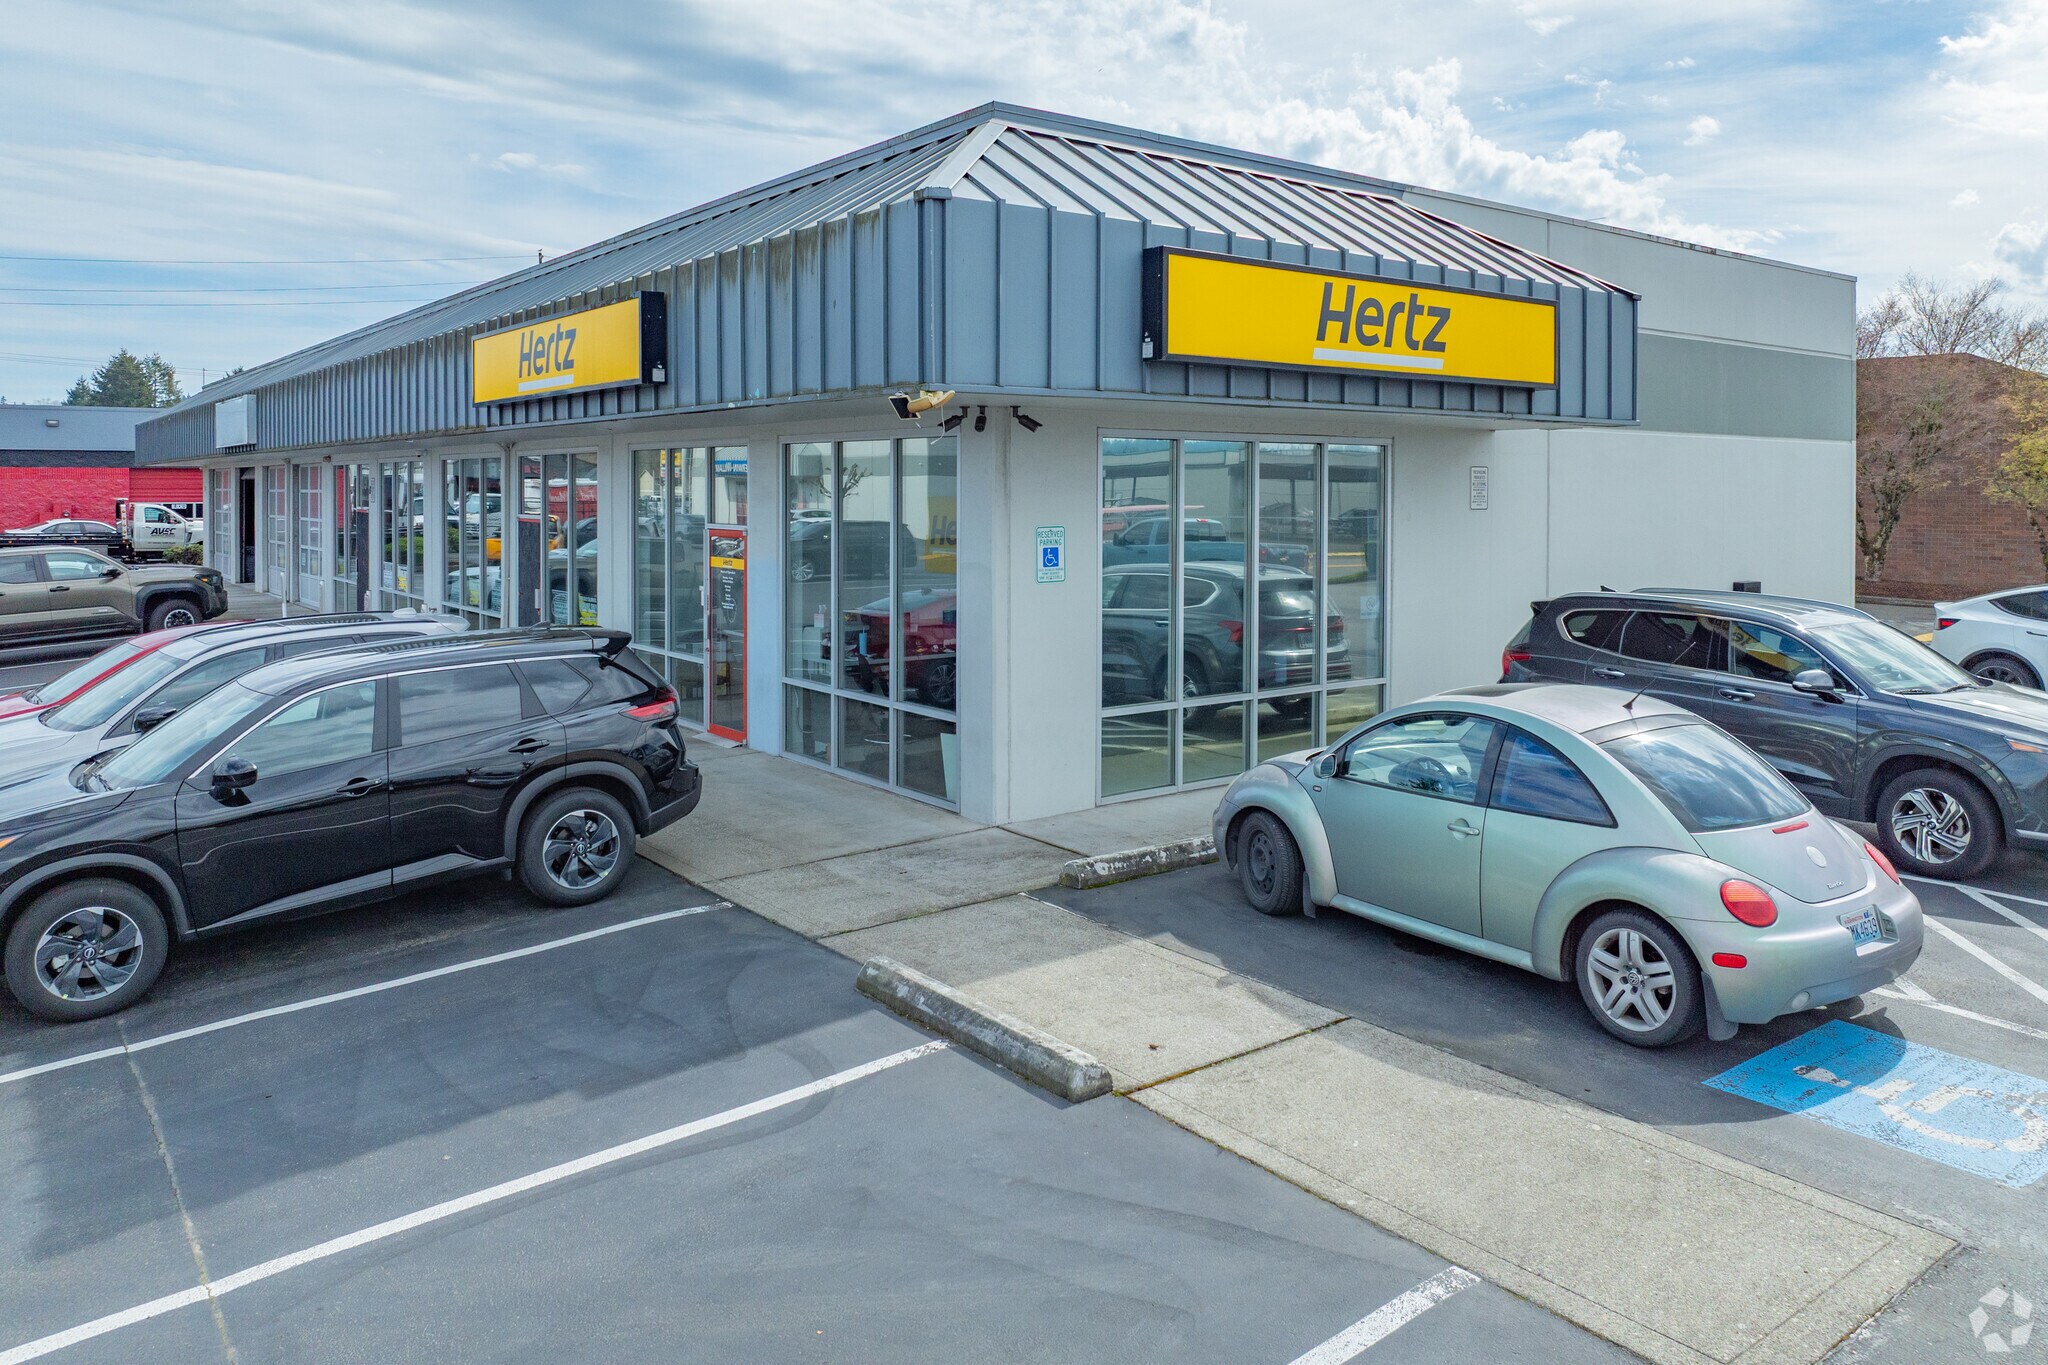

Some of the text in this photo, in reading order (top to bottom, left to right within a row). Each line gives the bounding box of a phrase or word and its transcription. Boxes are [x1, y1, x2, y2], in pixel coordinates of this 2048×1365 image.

[1316, 281, 1451, 353] Hertz
[518, 323, 577, 379] Hertz
[1038, 530, 1063, 538] RESERVED
[1040, 538, 1062, 546] PARKING
